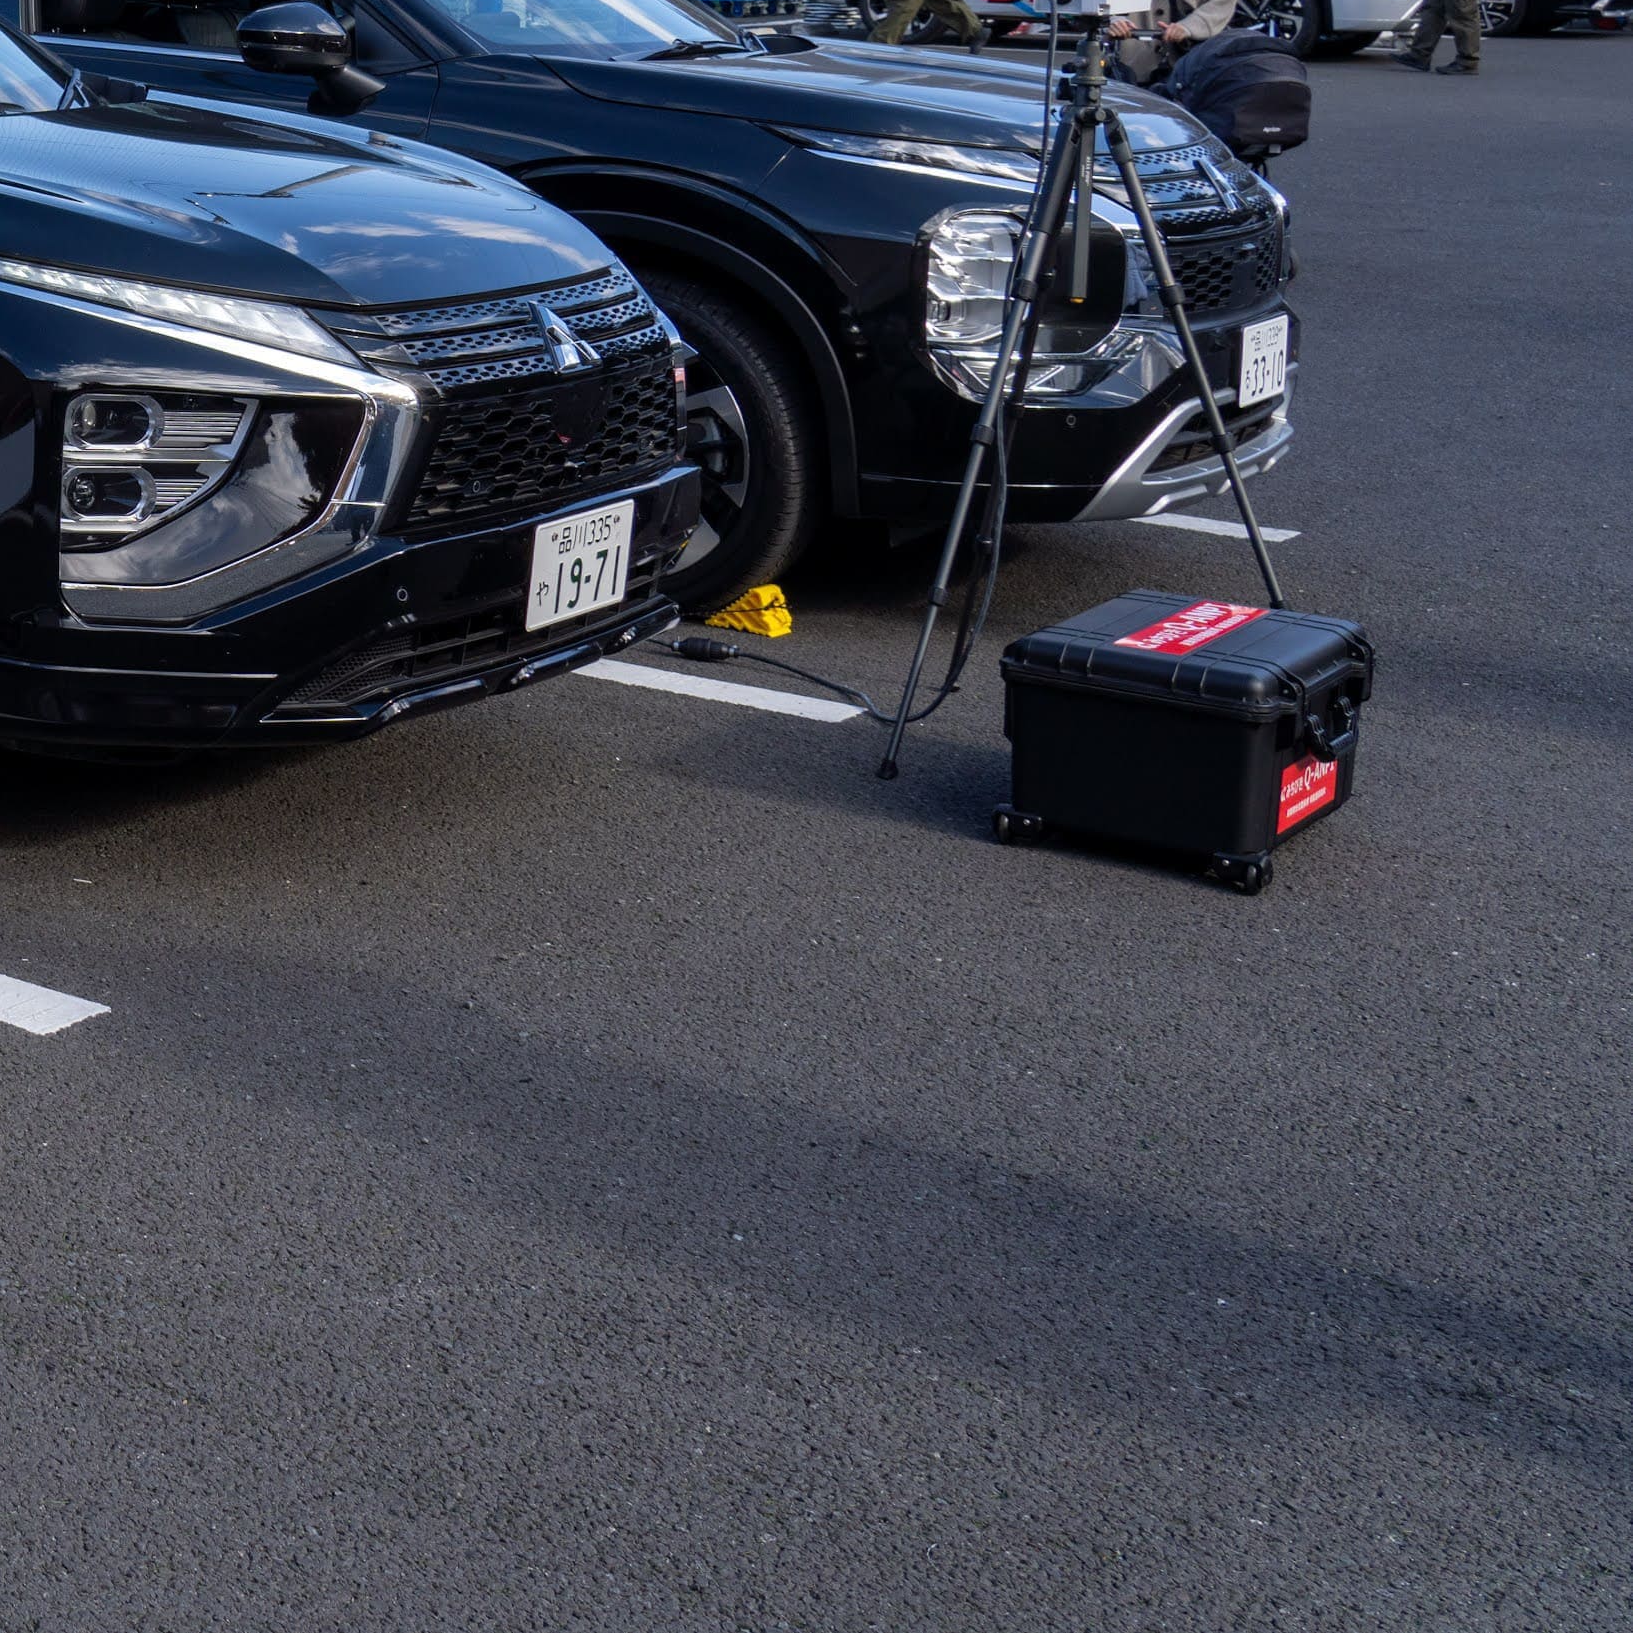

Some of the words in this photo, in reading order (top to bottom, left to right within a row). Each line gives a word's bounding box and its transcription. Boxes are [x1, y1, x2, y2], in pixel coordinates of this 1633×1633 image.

[1251, 349, 1284, 397] 33-10
[536, 580, 550, 608] や
[554, 545, 621, 614] 19-71
